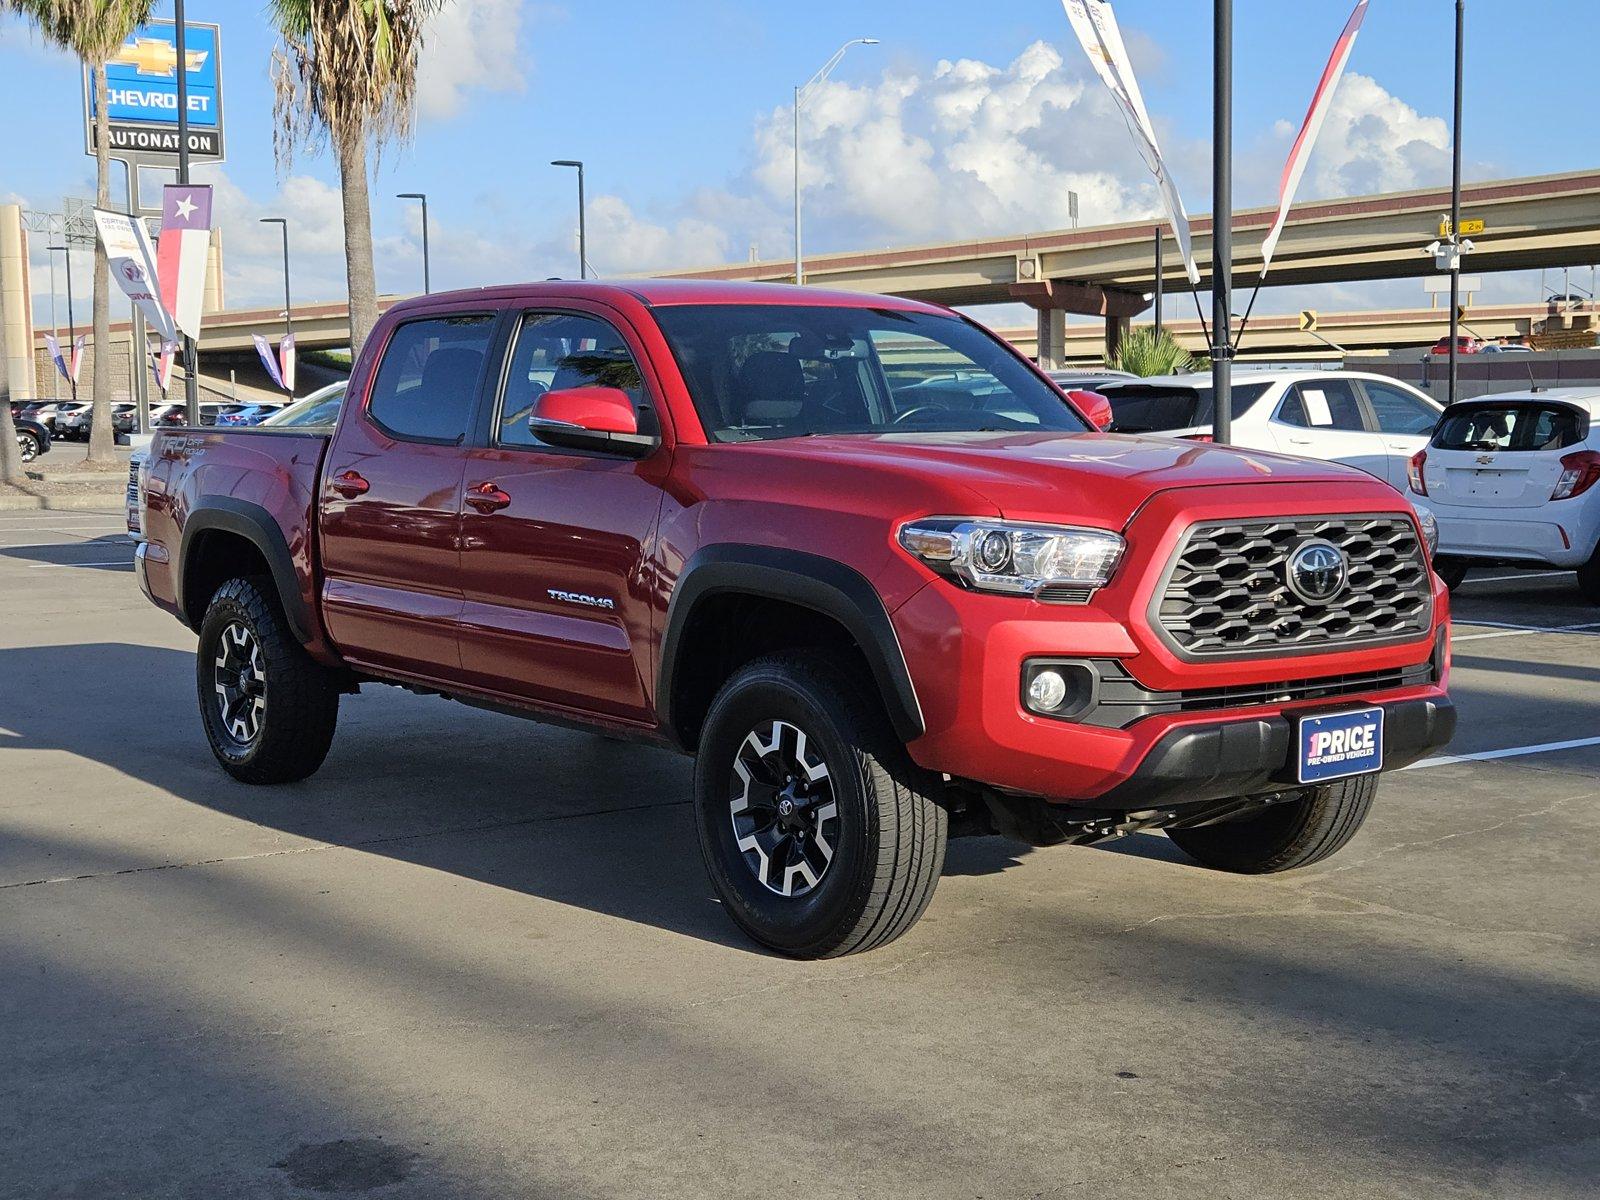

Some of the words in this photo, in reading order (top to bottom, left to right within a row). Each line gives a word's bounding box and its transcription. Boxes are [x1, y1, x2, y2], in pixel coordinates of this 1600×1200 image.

[106, 89, 210, 111] HEVROET
[107, 131, 211, 150] AUTONATON
[160, 435, 187, 455] TRD
[186, 438, 204, 447] OFF
[547, 589, 614, 609] TACOMA
[1307, 753, 1345, 766] PRE-OWNED
[1346, 748, 1375, 760] VEHICLES
